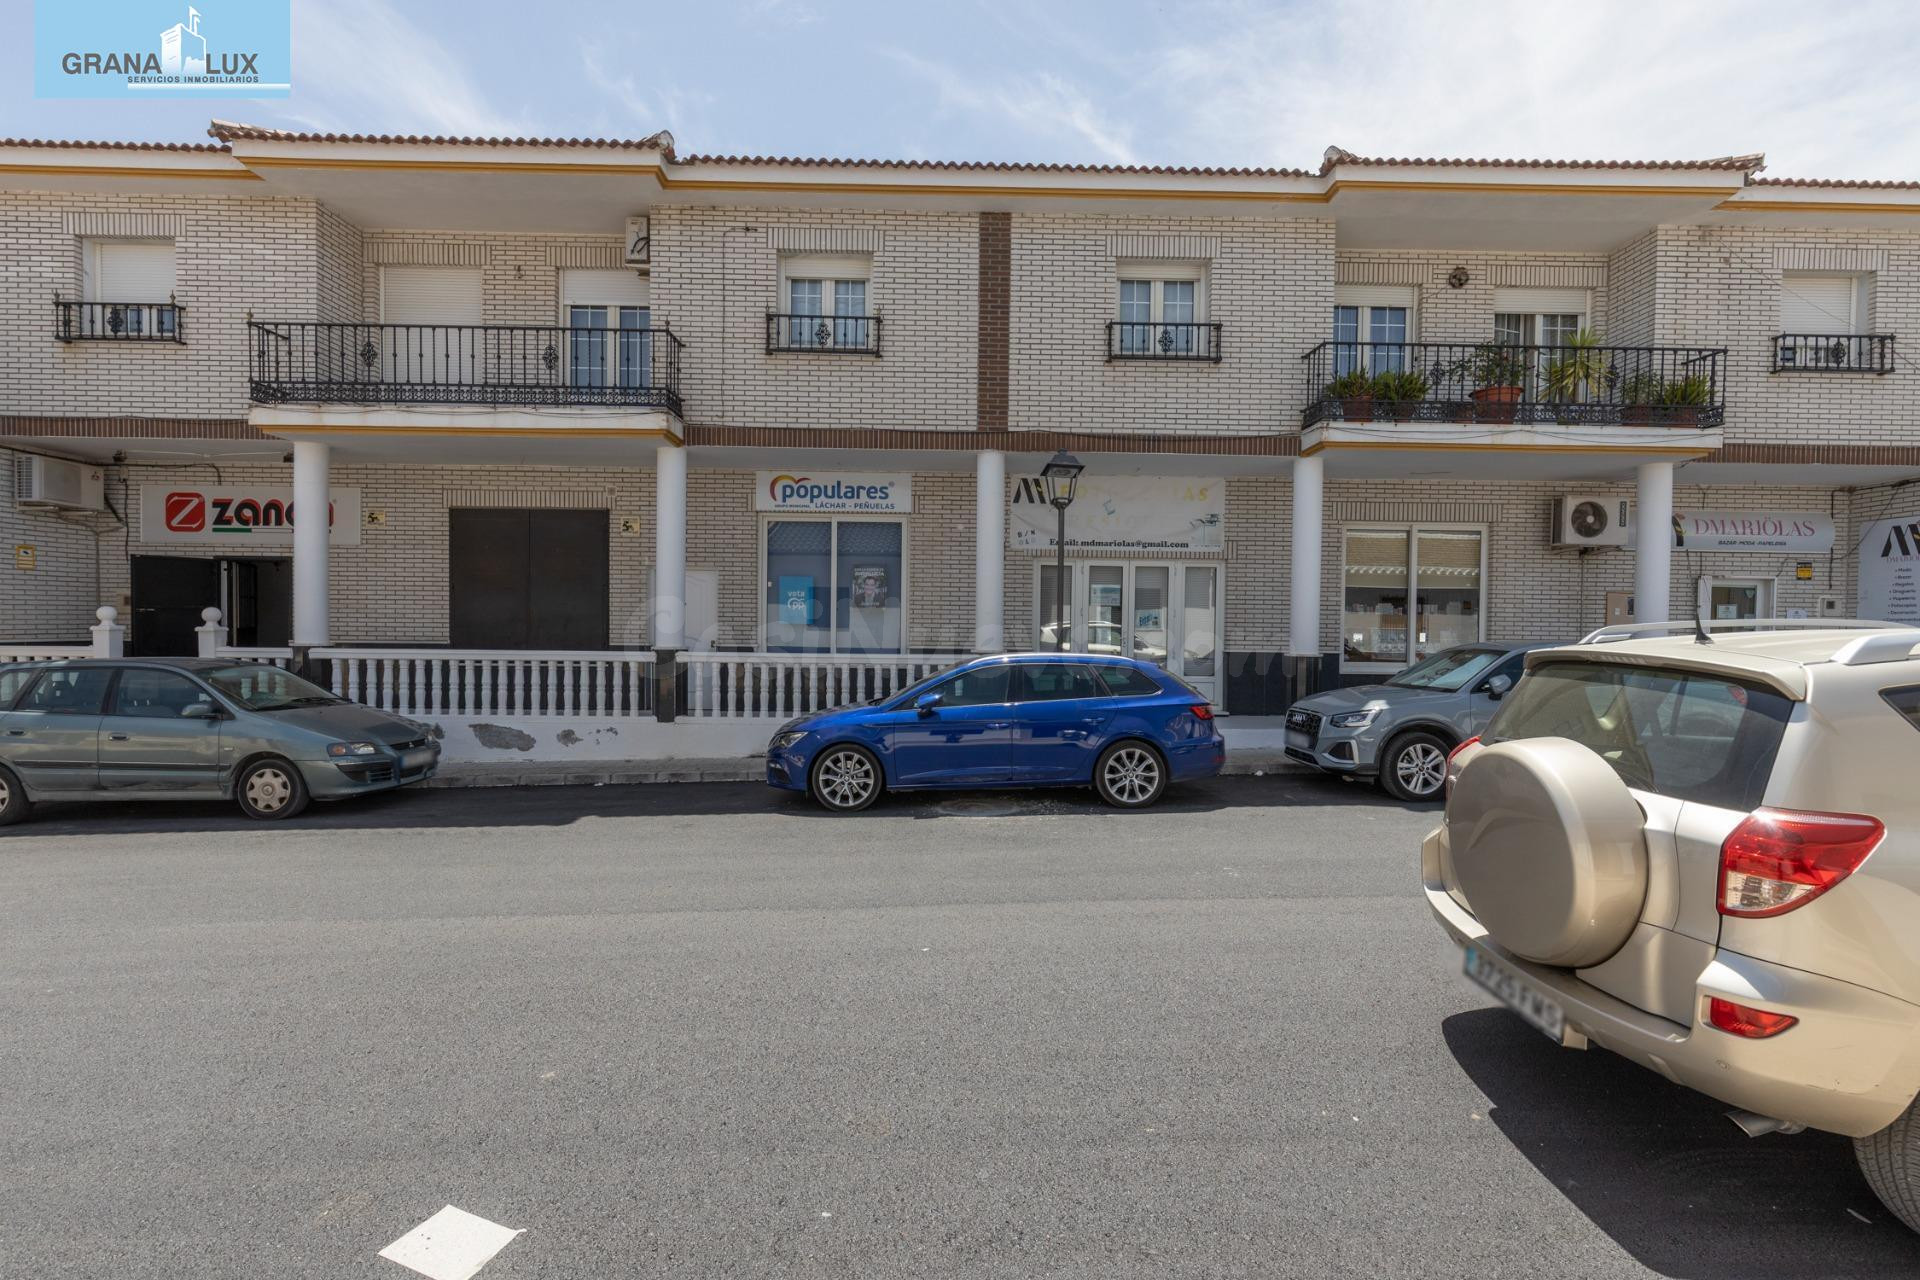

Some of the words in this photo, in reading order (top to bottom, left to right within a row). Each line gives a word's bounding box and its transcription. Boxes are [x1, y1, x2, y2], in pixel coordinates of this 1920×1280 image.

[782, 480, 889, 503] populares
[815, 500, 846, 509] LÁCHAR
[854, 501, 895, 510] PEÑUELAS
[1080, 540, 1189, 549] mdmariolas@gmail.com
